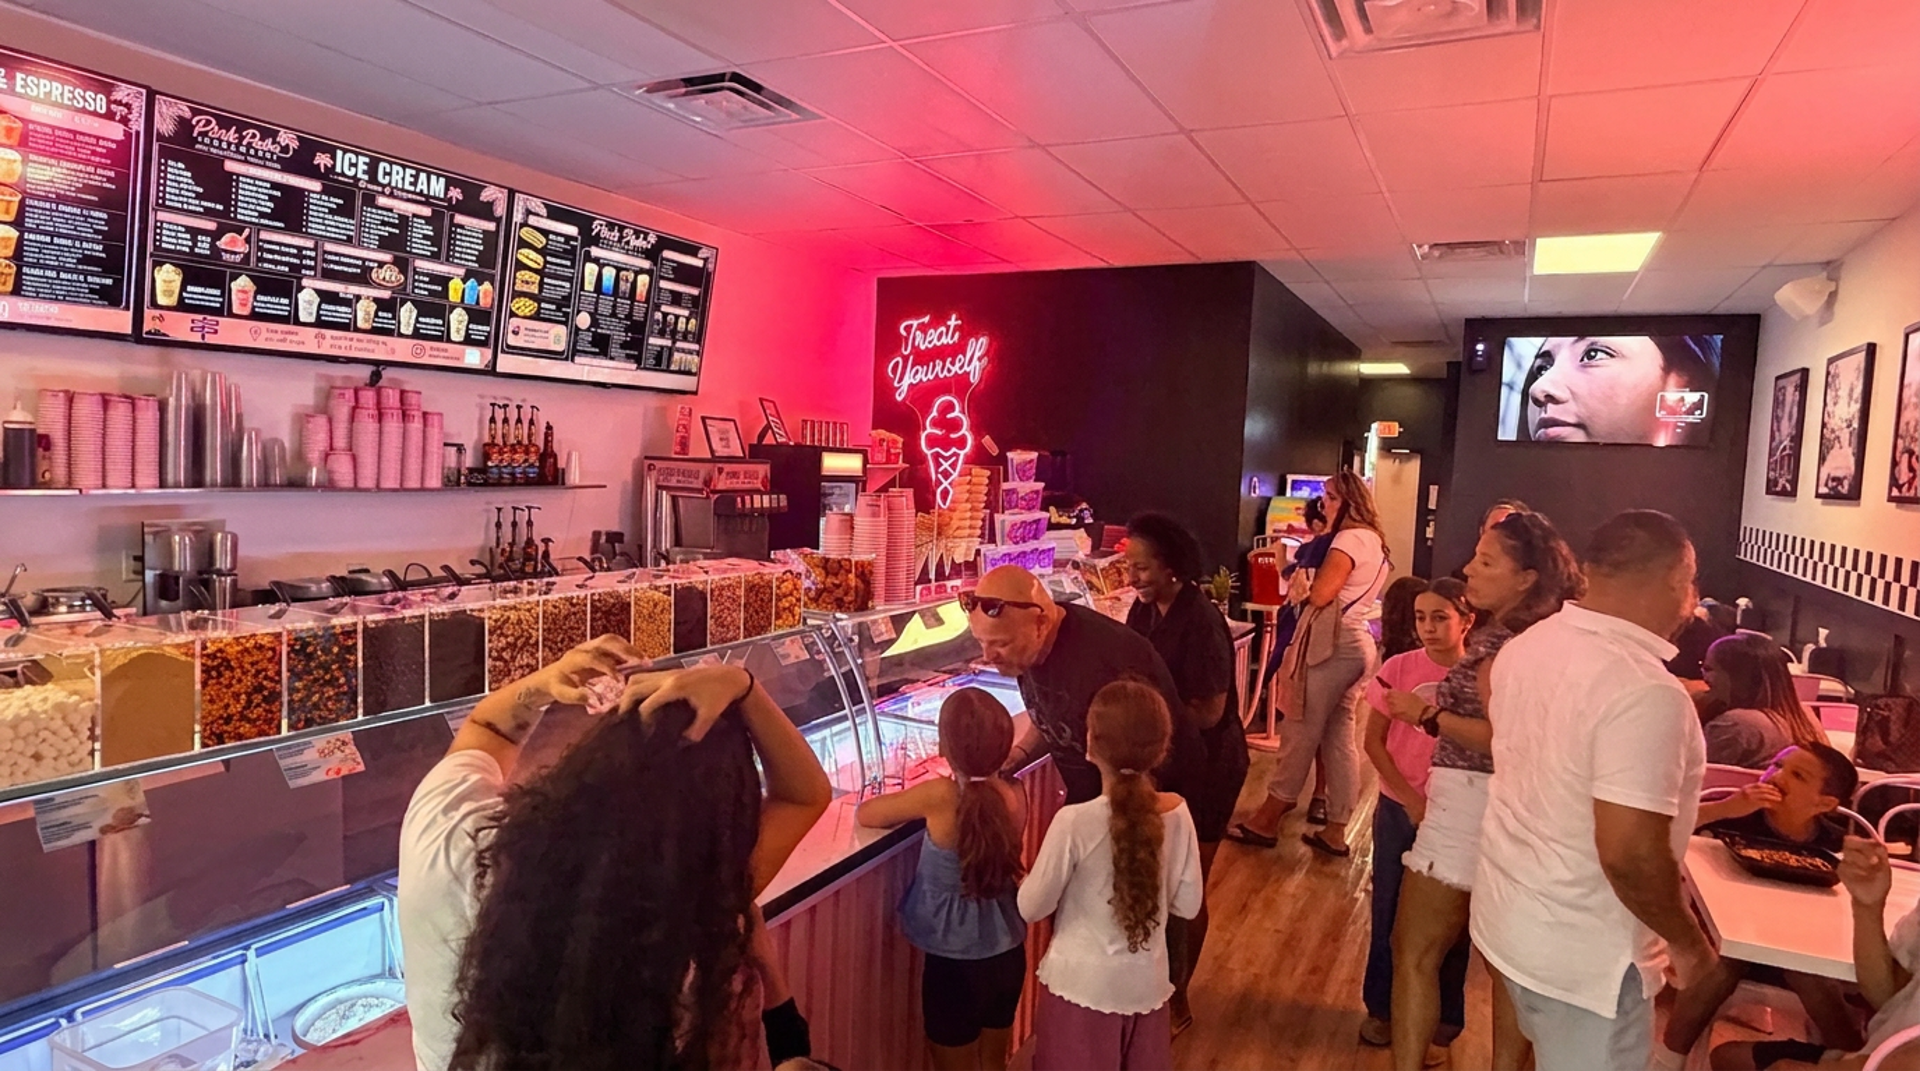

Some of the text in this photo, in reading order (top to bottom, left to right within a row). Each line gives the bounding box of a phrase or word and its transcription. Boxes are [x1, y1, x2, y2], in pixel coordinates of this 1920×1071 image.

[15, 72, 107, 114] ESPRESSO
[335, 149, 370, 181] ICE
[377, 161, 446, 199] CREAM
[899, 314, 962, 355] Treat
[887, 336, 989, 402] Yourself
